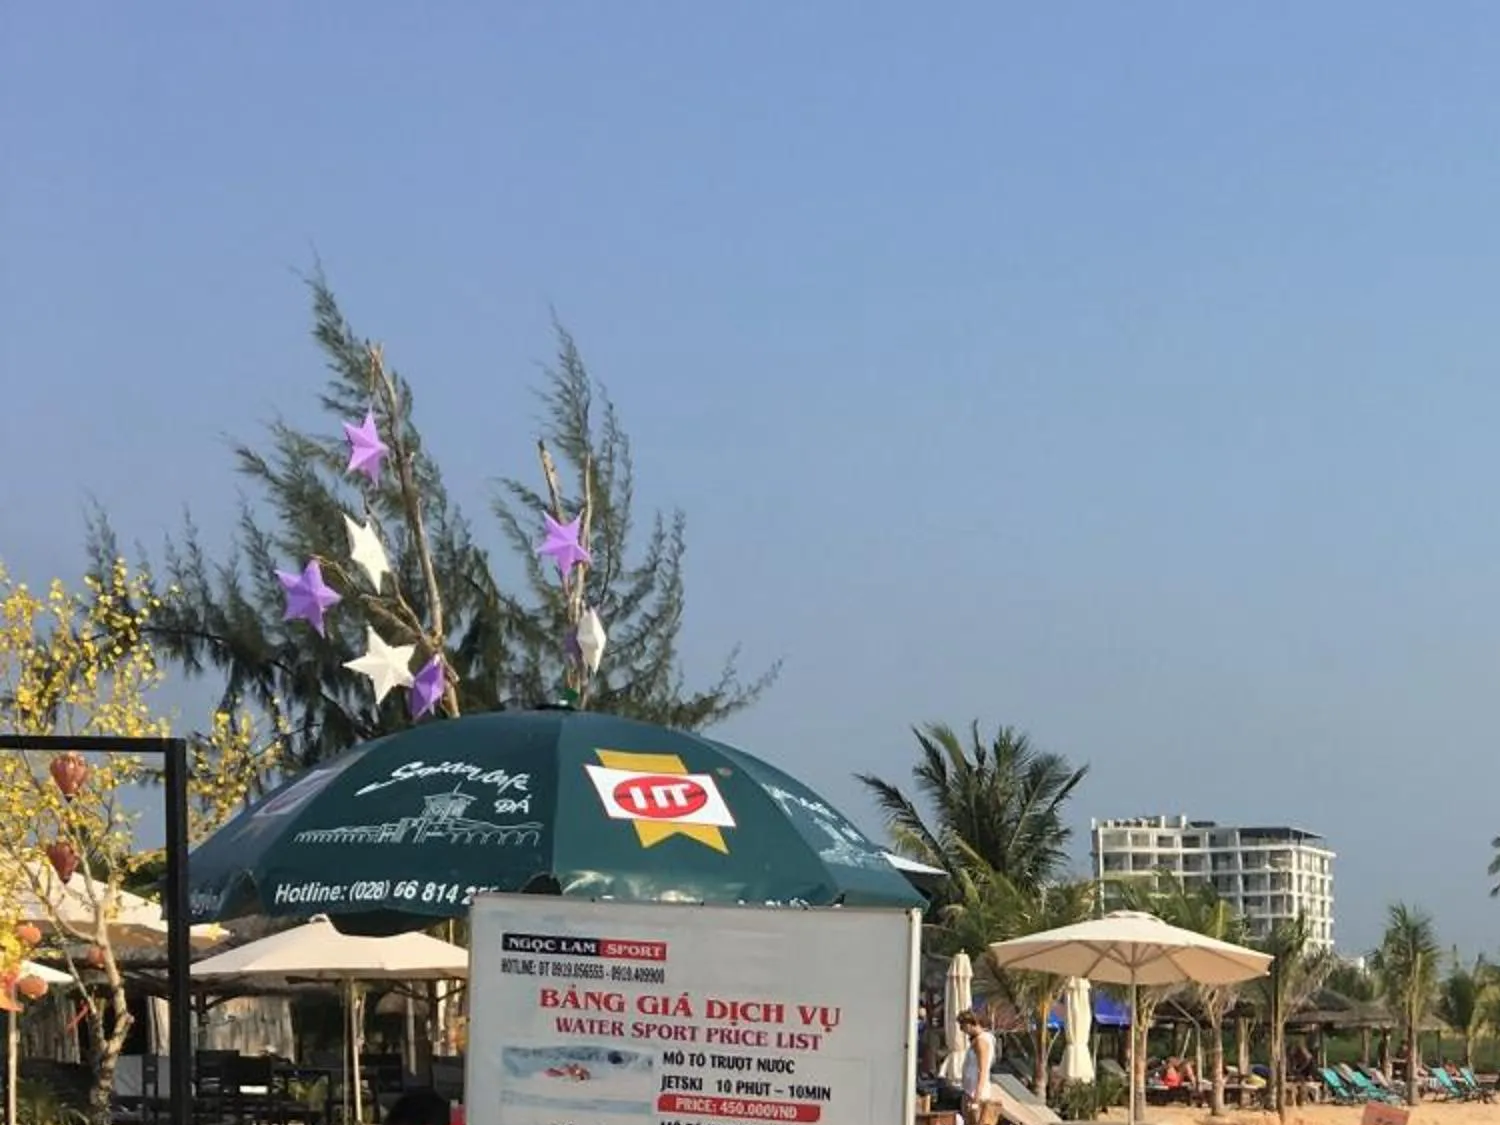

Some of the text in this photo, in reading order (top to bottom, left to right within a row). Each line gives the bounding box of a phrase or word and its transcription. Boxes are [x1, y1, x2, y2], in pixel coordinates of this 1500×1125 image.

[275, 880, 347, 904] Hotline:
[350, 880, 390, 902] (028)
[421, 881, 460, 904] 814
[607, 943, 661, 957] SPORT
[540, 985, 841, 1033] BẢNG GIÁ DỊCH VỤ
[555, 1017, 823, 1051] WATER SPORT PRICE LIST
[661, 1076, 703, 1092] JETSKI
[717, 1079, 731, 1093] 10
[788, 1085, 831, 1100] 10MIN
[676, 1098, 717, 1113] PRICE:
